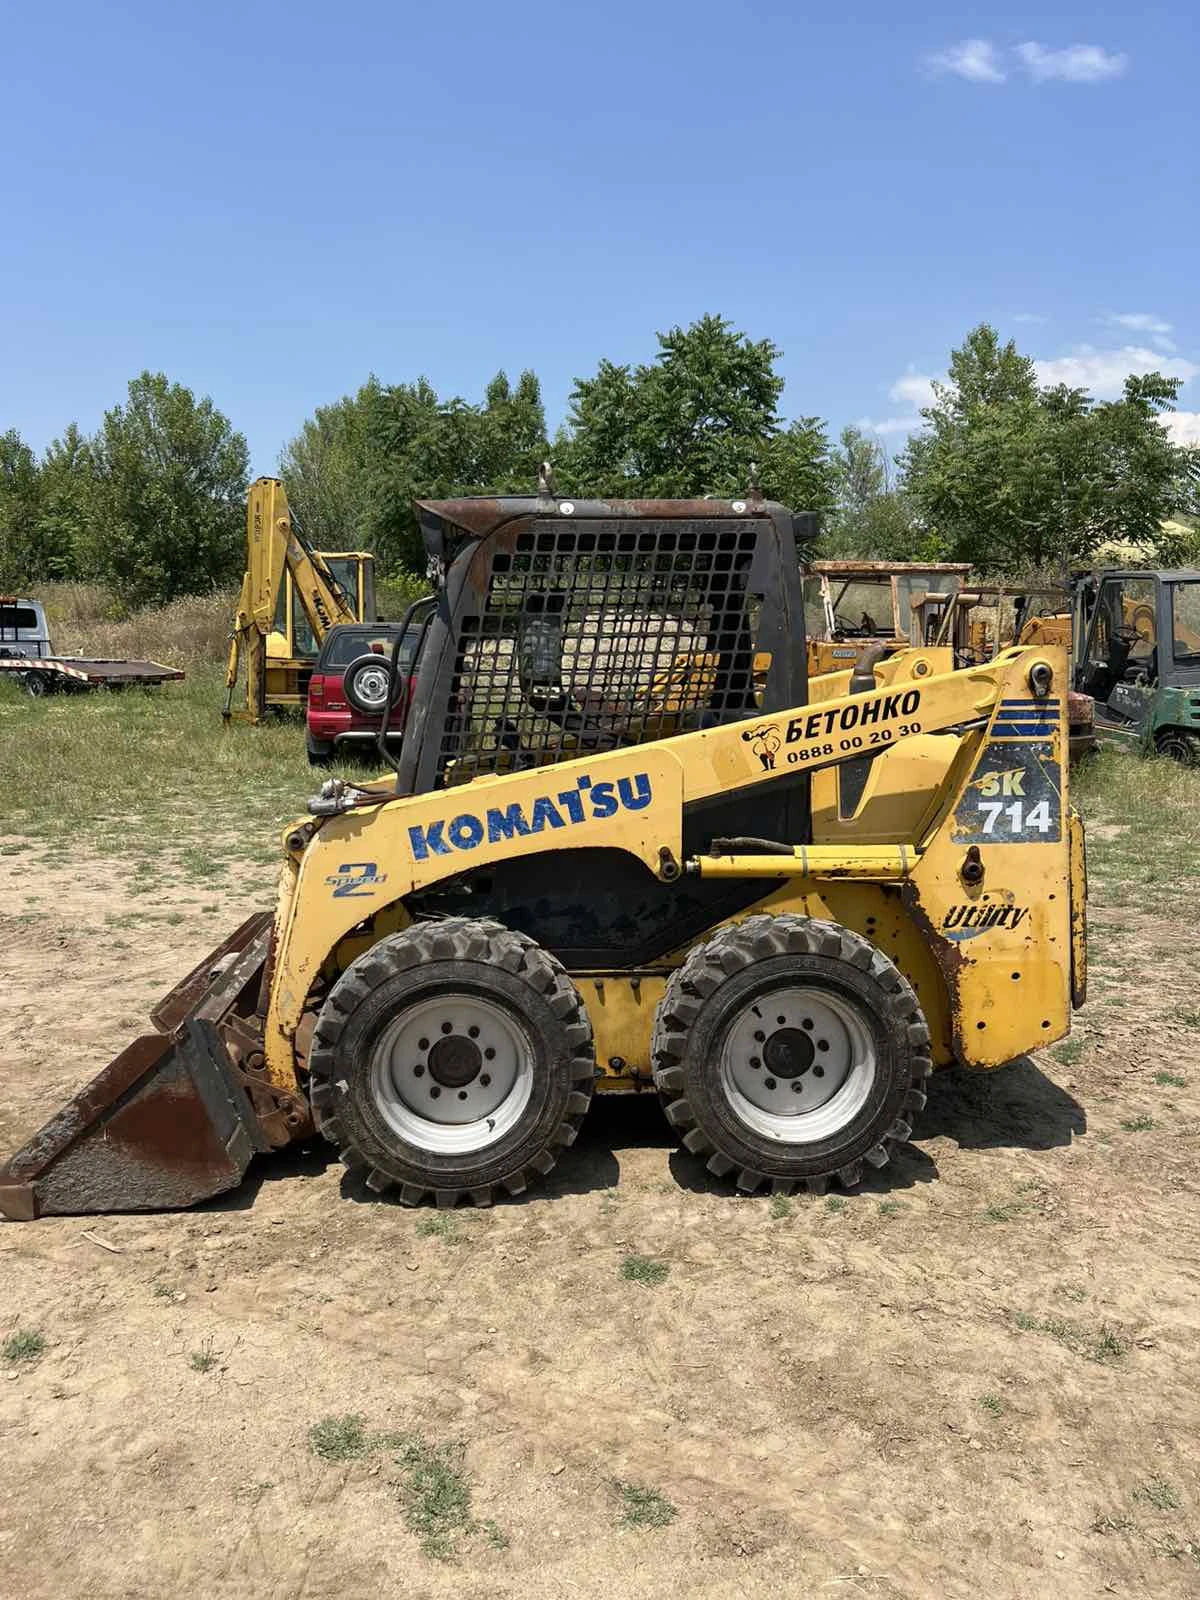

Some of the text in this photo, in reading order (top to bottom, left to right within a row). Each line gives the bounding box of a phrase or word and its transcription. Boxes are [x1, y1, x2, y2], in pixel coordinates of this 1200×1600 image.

[785, 689, 921, 744] БЕТОНКО
[787, 722, 922, 764] 0888 00 20 30
[977, 770, 1026, 797] SK
[408, 773, 653, 861] KOMATSU
[978, 801, 1053, 834] 714
[943, 903, 1029, 931] Utility
